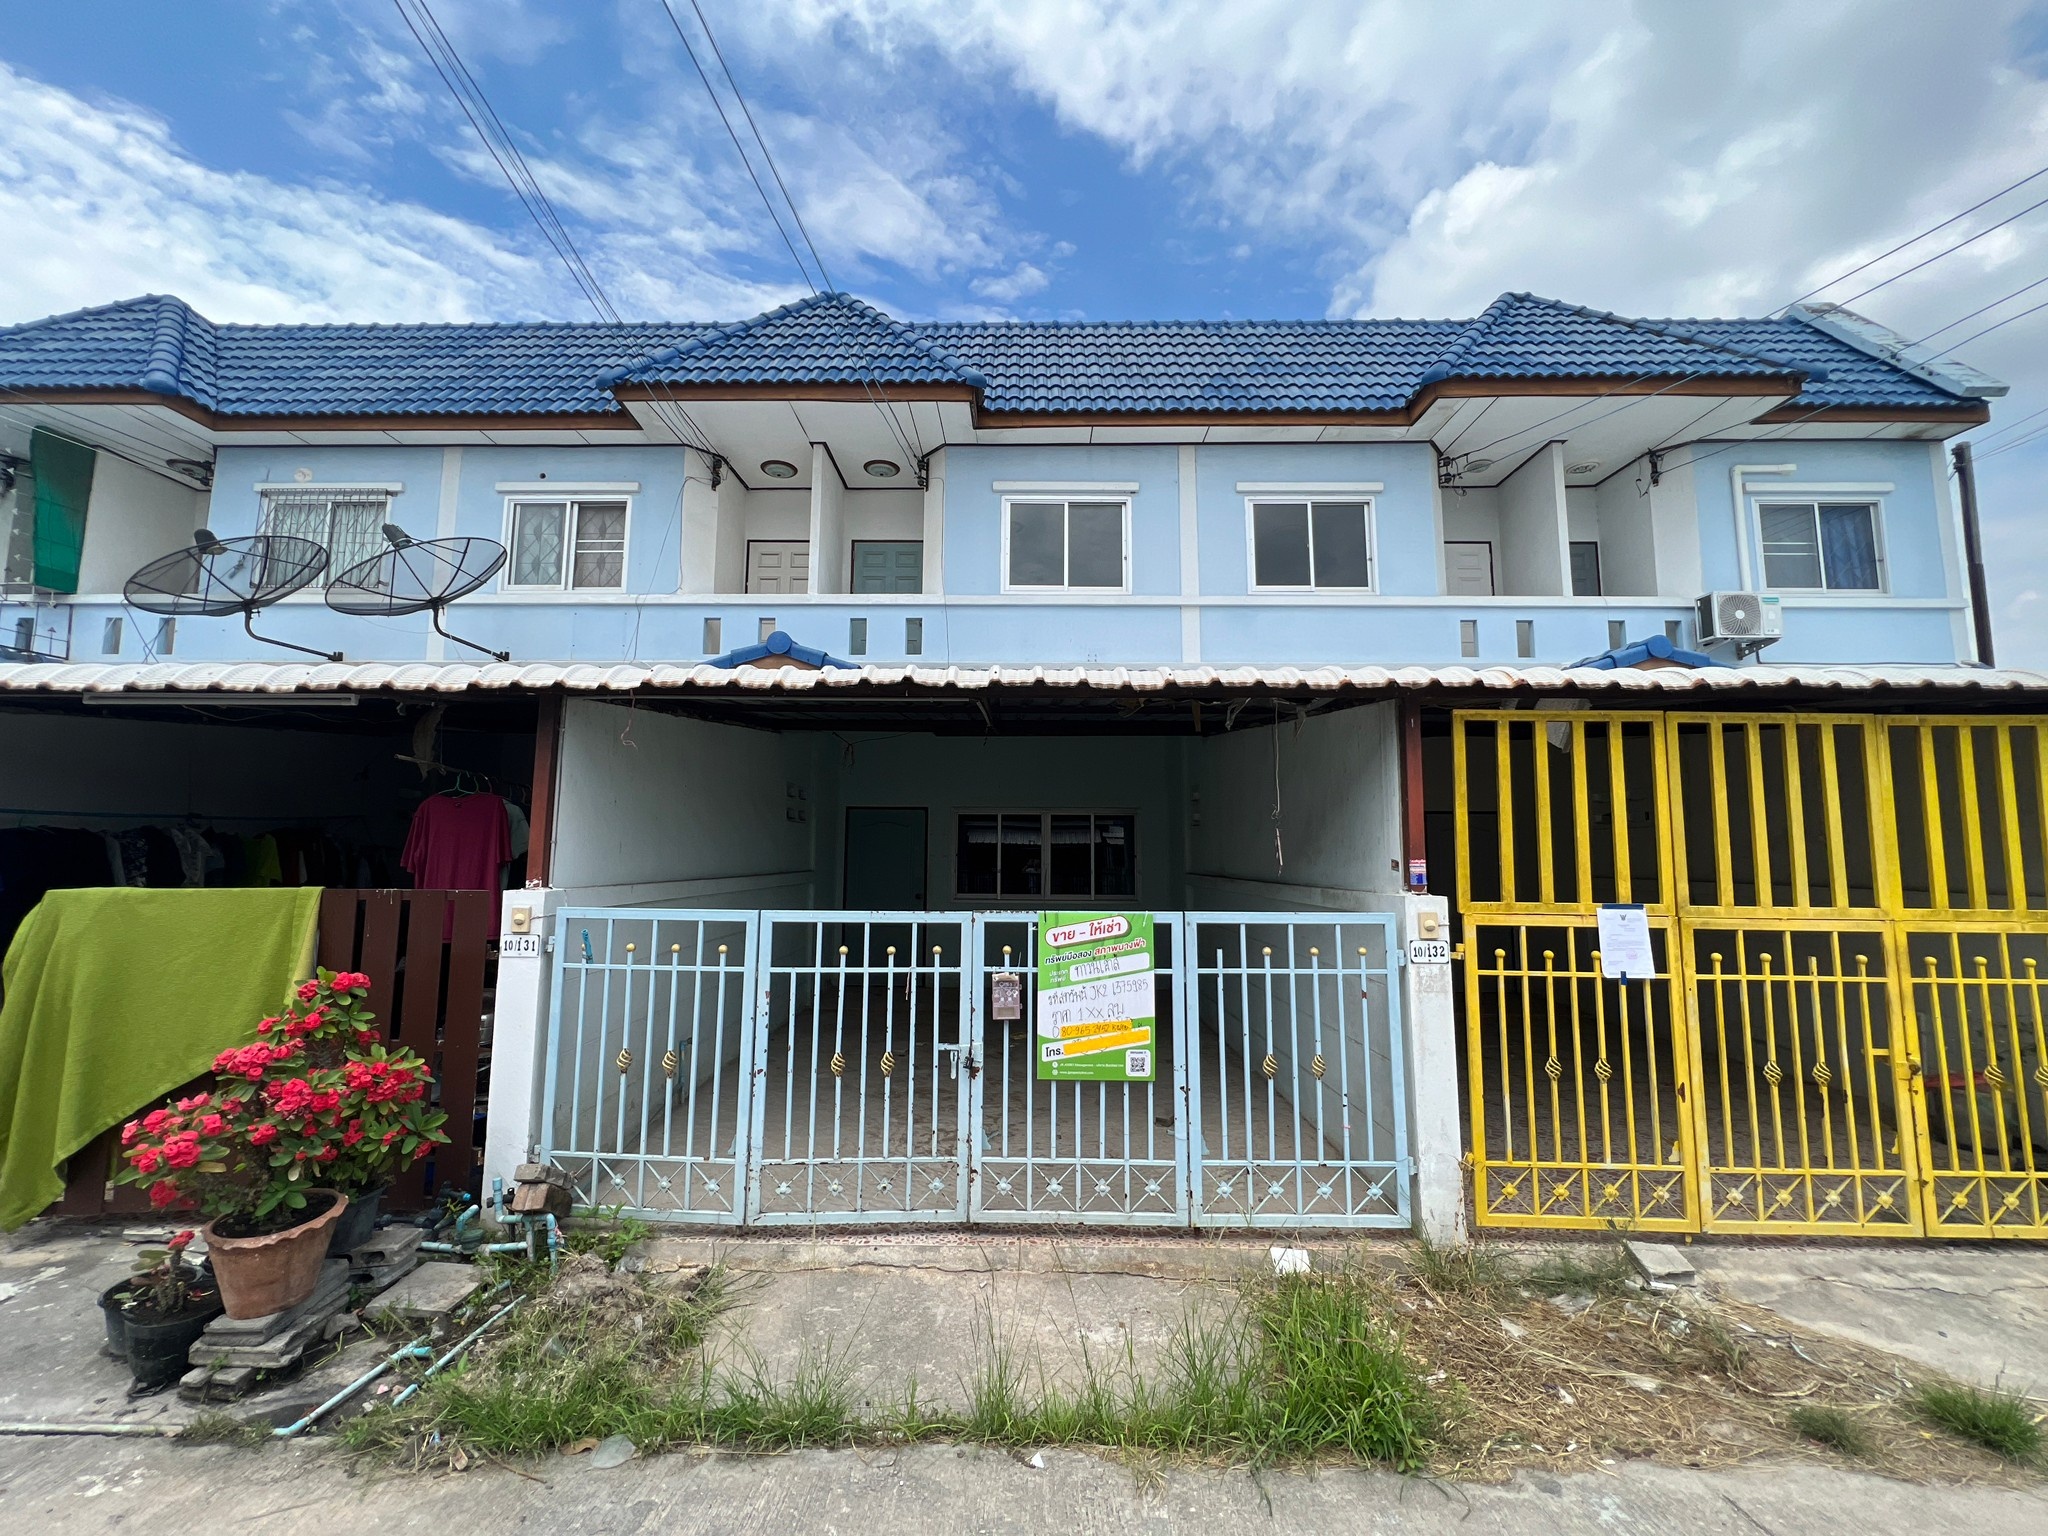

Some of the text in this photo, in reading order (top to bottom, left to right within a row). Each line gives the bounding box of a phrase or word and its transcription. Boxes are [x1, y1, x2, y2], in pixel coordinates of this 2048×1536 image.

[1052, 929, 1076, 943] ขาย
[1089, 919, 1122, 937] ให้เช่า
[504, 939, 536, 952] 10/131
[1045, 937, 1146, 964] ทรัพย์มือสอง สภาพนางฟ้า
[1413, 945, 1445, 958] 10/132
[1045, 1046, 1064, 1058] โทร.
